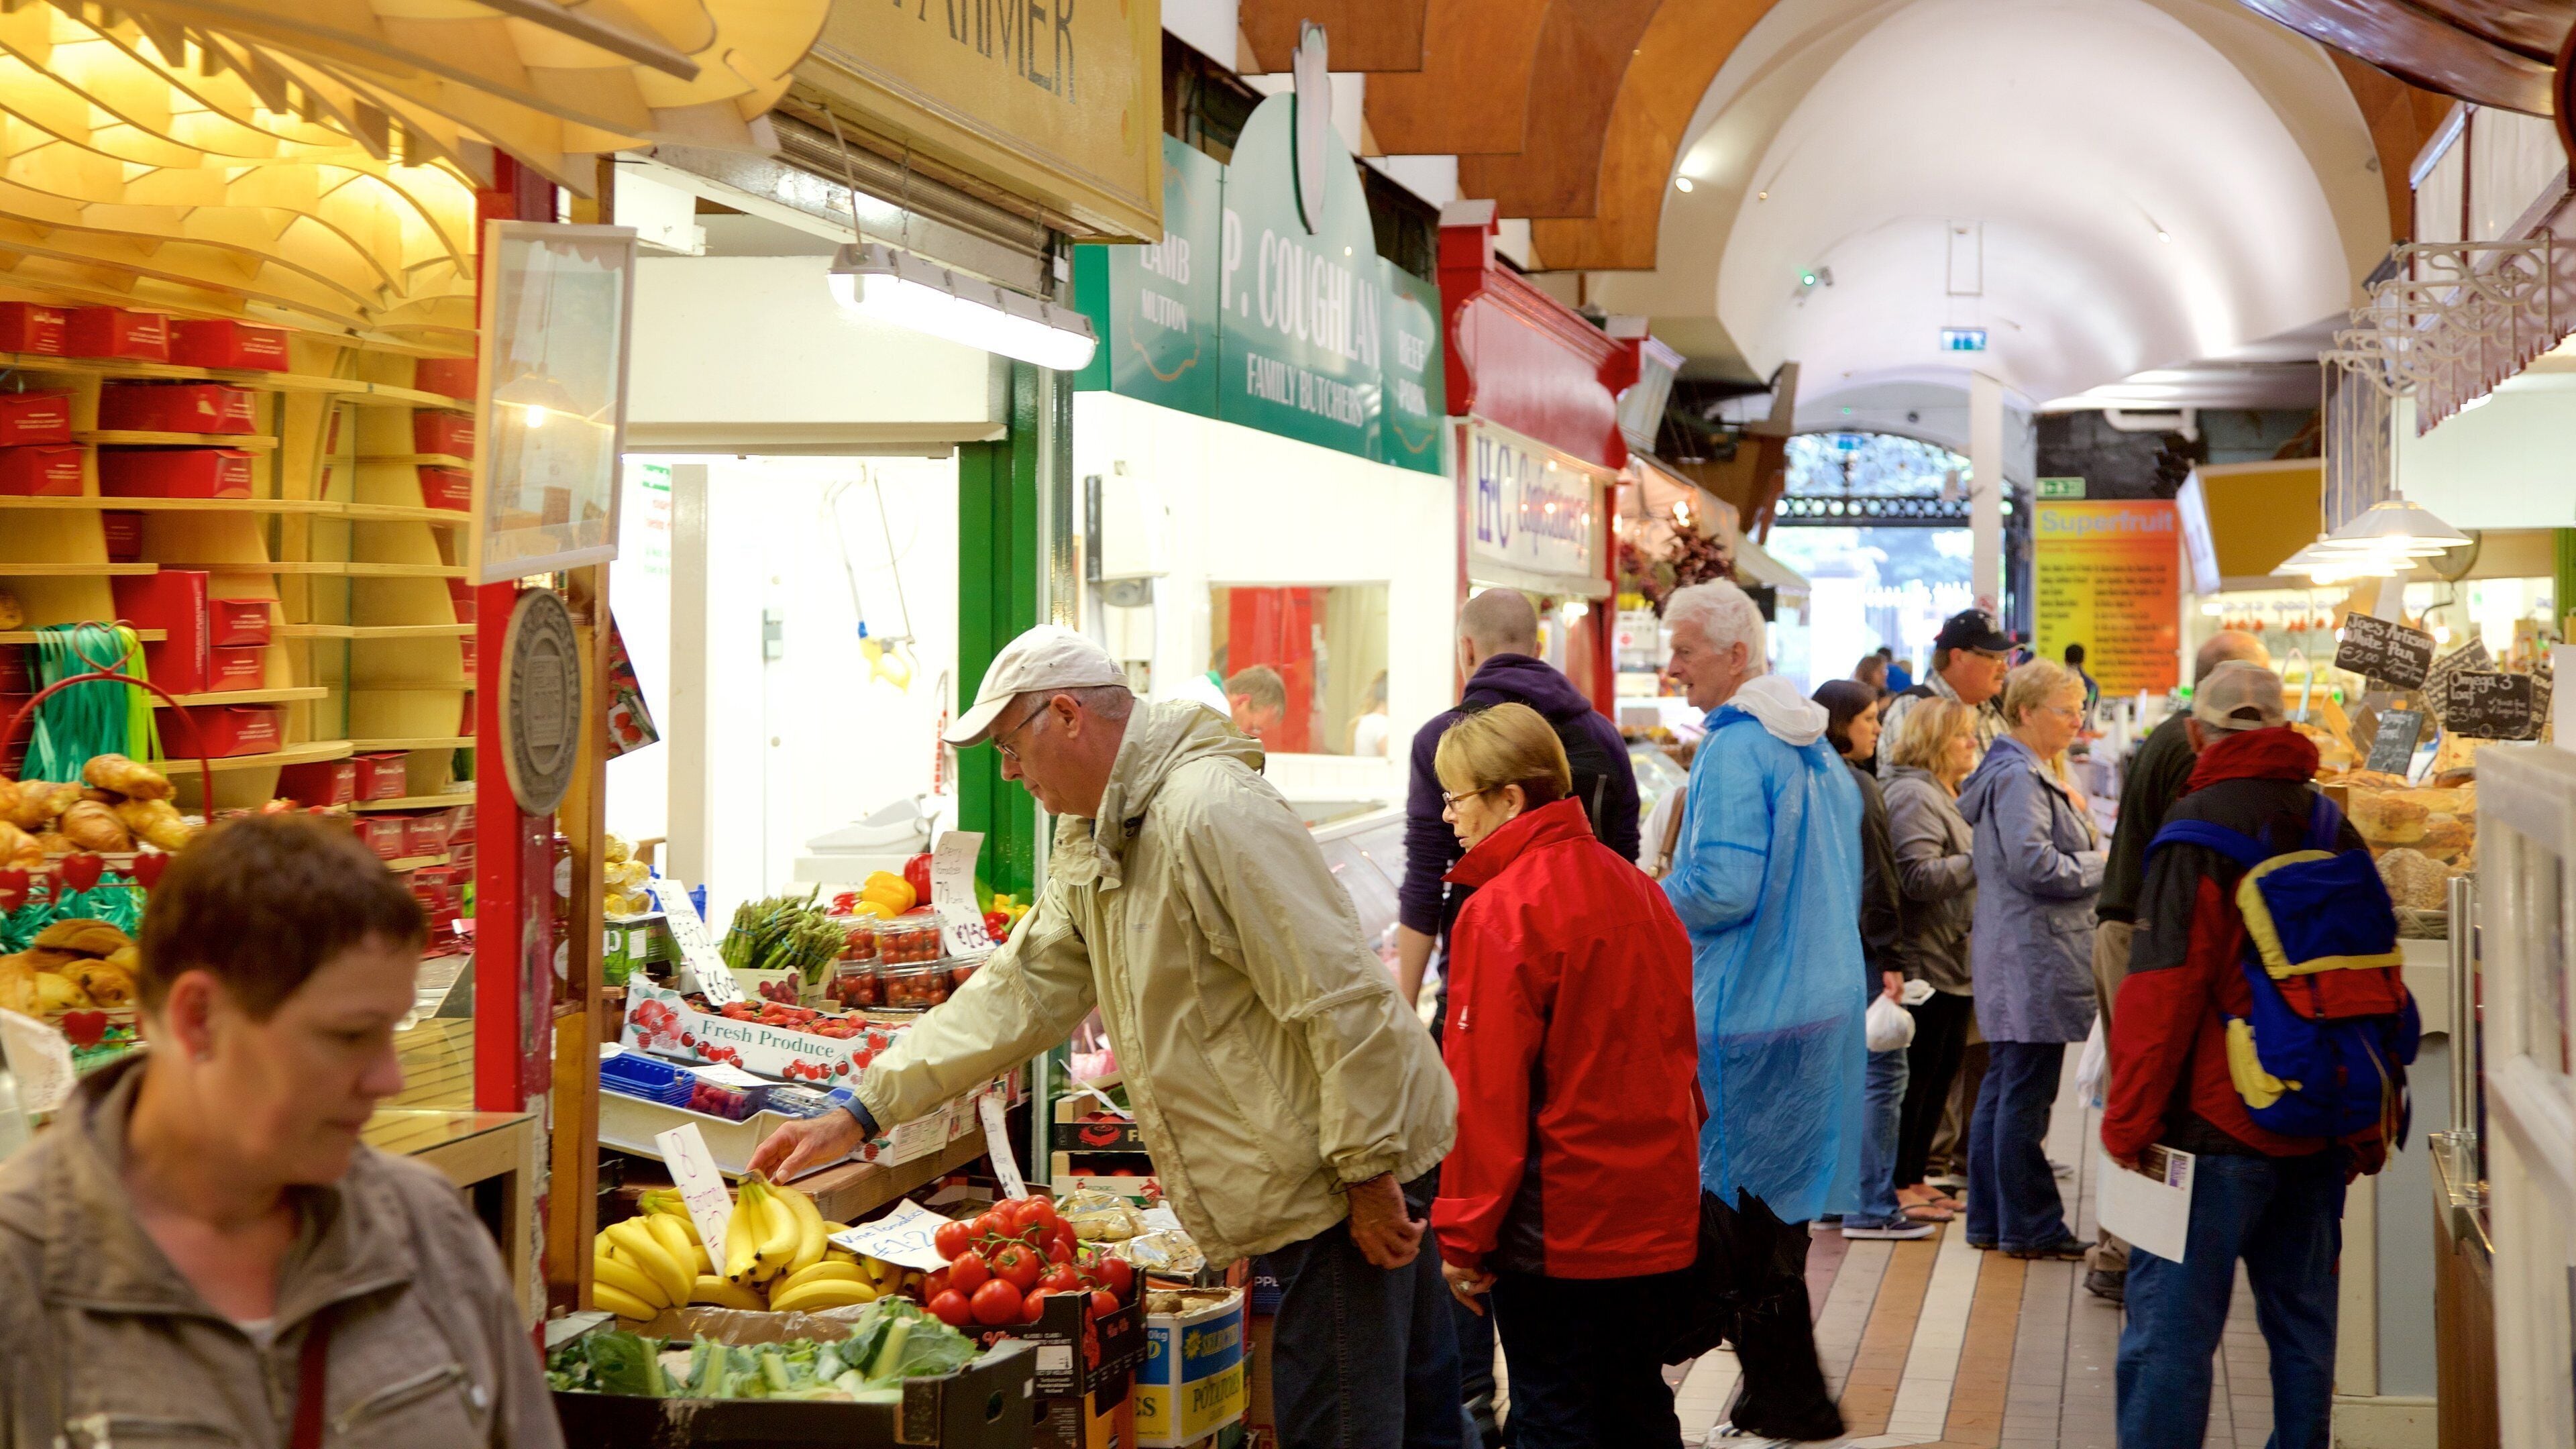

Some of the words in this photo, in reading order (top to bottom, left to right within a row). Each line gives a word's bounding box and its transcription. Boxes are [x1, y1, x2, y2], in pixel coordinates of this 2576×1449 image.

[1141, 231, 1190, 285] LAMB
[1221, 207, 1249, 318] P.
[1258, 228, 1381, 370] COUGHLAN
[1142, 288, 1187, 333] MUTTON
[1246, 352, 1297, 407] FAMILY
[1299, 369, 1364, 427] BUTCHERS
[2041, 510, 2173, 536] Superfruit
[2449, 671, 2497, 694] Omega
[2500, 673, 2514, 691] 3
[702, 1020, 752, 1042] Fresh
[758, 1030, 835, 1058] Produce
[836, 1232, 876, 1244] Vine
[865, 1208, 925, 1232] Tomatoes
